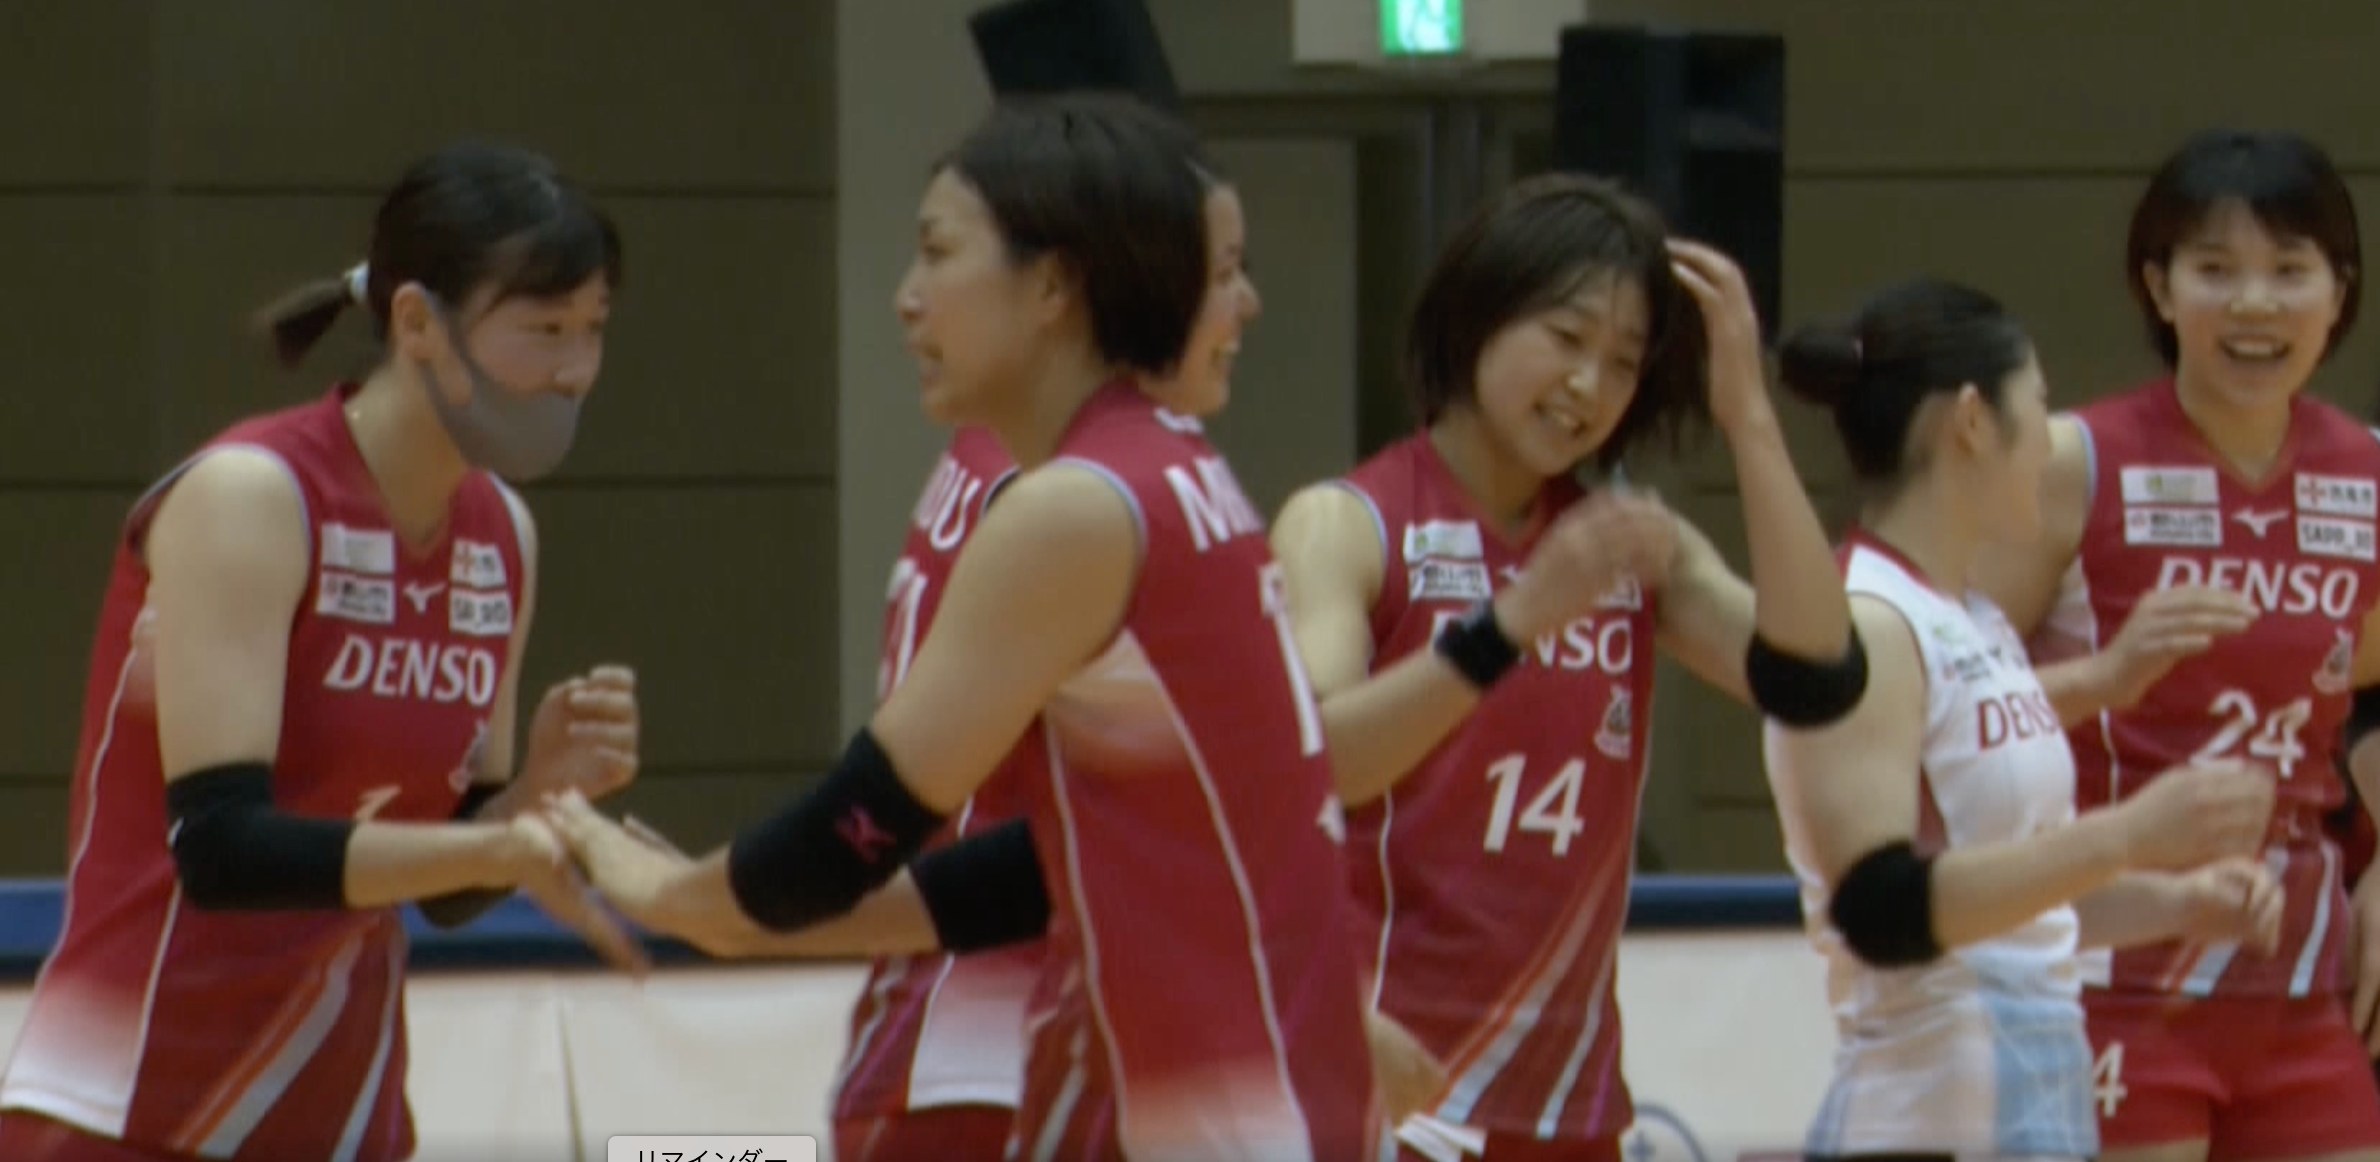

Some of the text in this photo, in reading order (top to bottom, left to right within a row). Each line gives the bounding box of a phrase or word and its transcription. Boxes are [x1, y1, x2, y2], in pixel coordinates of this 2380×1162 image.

[323, 634, 496, 707] DENSO
[2188, 688, 2313, 779] 24
[1483, 752, 1587, 858] 14
[2092, 1039, 2128, 1118] 4
